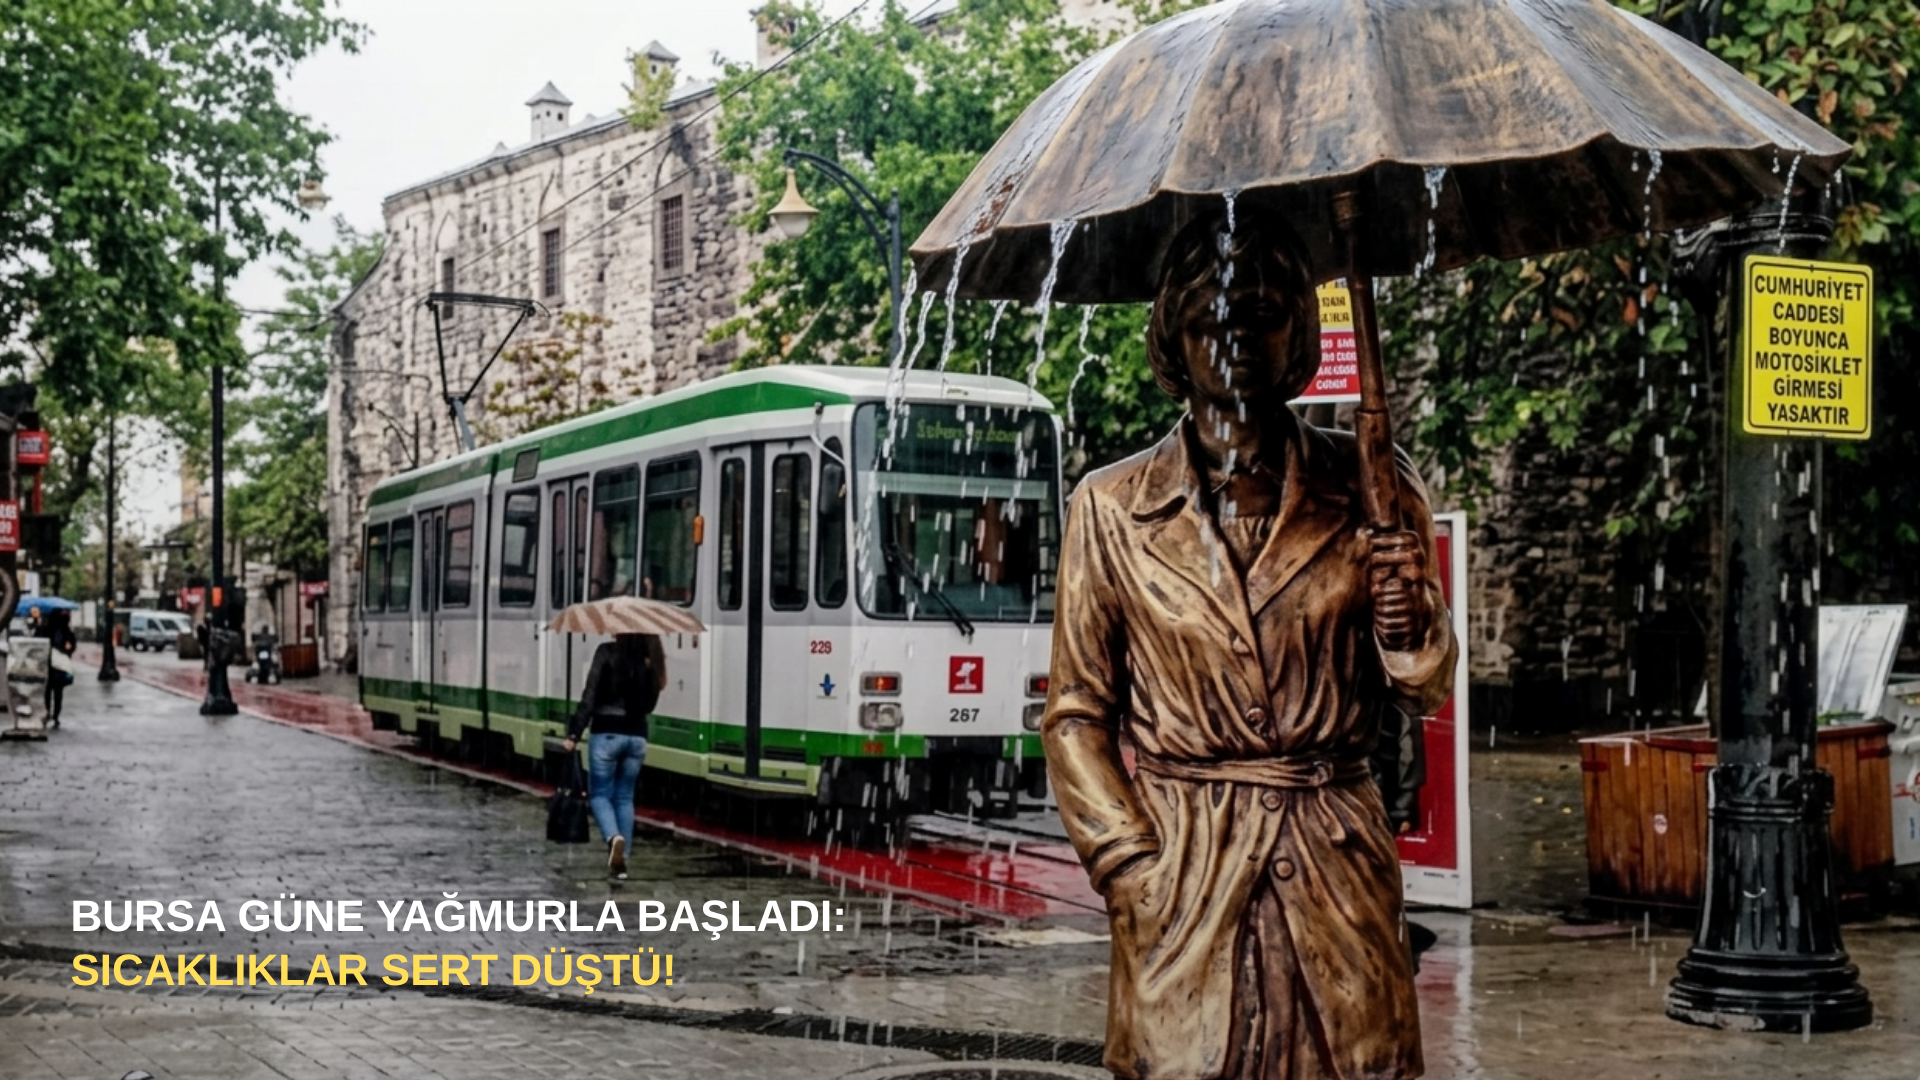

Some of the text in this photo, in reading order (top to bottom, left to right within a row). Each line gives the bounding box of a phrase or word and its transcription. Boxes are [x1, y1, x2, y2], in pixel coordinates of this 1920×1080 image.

[1754, 275, 1864, 301] CUMHURİYET
[1773, 302, 1844, 325] CADDESİ
[1769, 327, 1849, 350] BOYUNCA
[1755, 350, 1862, 375] MOTOSİKLET
[1773, 374, 1842, 400] GİRMESİ
[1767, 402, 1849, 425] YASAKTIR
